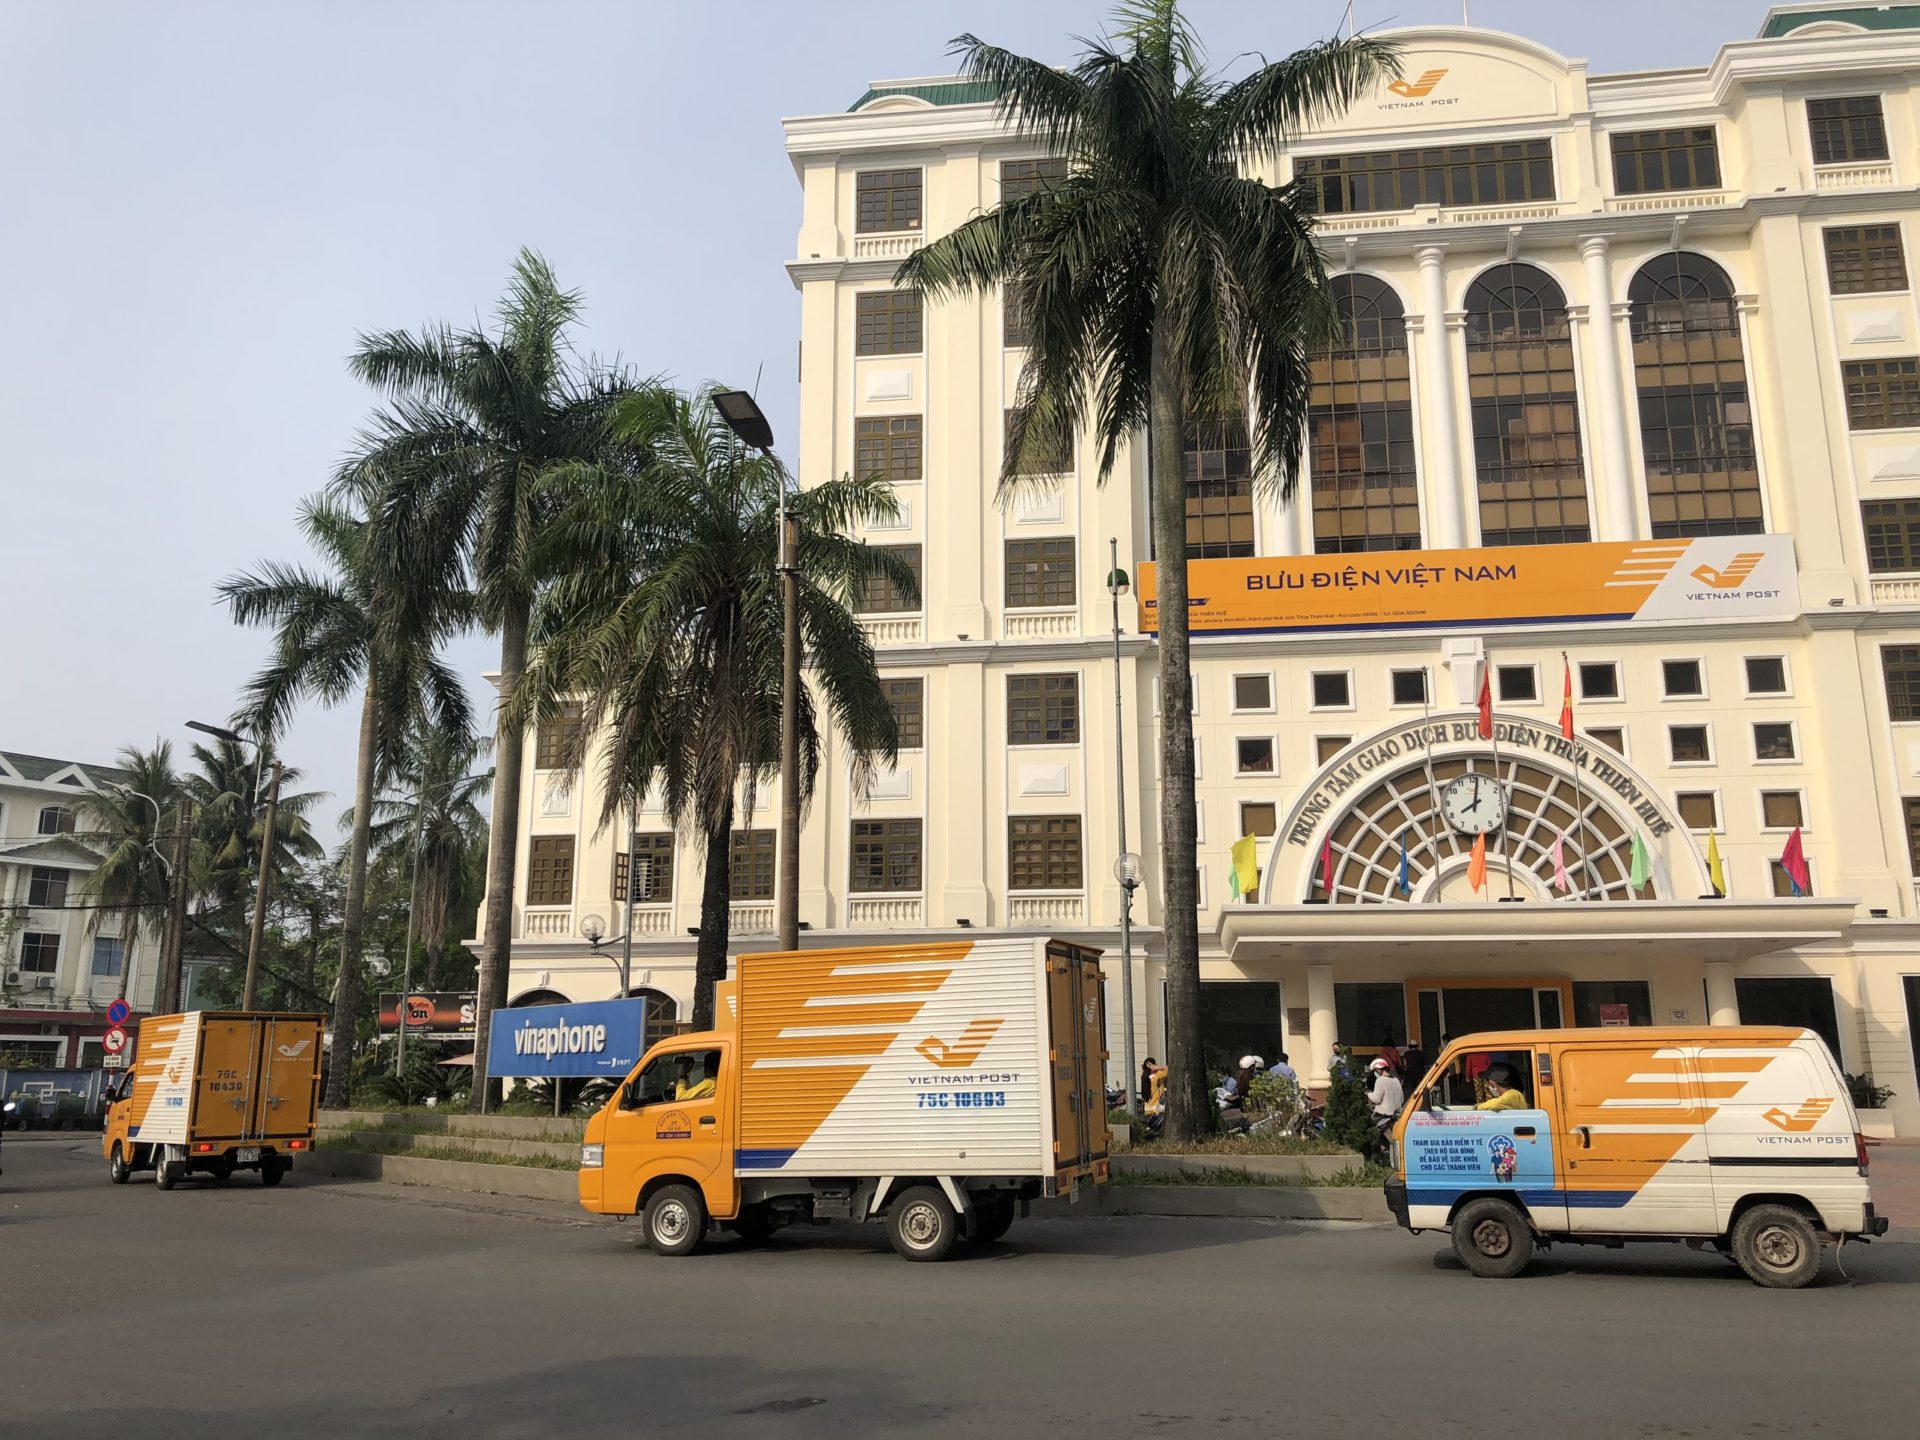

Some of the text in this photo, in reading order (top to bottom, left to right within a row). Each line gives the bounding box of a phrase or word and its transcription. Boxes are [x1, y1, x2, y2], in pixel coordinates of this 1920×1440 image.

[1377, 98, 1460, 111] VIETNAM POST
[1246, 563, 1517, 591] BƯU ĐIỆN VIỆT NAM
[1685, 590, 1781, 601] VIETNAM POST
[1288, 792, 1331, 847] TRUNG
[1357, 739, 1401, 772] GIAO
[1400, 724, 1449, 751] DỊCH
[1452, 720, 1492, 742] BƯ
[1495, 723, 1541, 749] ĐIỆN
[1590, 756, 1642, 804] THIÊN
[1634, 799, 1674, 838] HUẾ
[514, 1017, 606, 1061] vinaphone
[217, 1070, 238, 1079] 75C
[908, 1073, 1021, 1085] VIETNAM POST
[1441, 1137, 1453, 1146] BẢO
[1454, 1137, 1470, 1146] HIỂM
[1476, 1138, 1483, 1146] TẾ
[1756, 1136, 1850, 1144] VIETNAM POST
[1440, 1147, 1448, 1155] HỘ
[1429, 1154, 1440, 1162] BẢO
